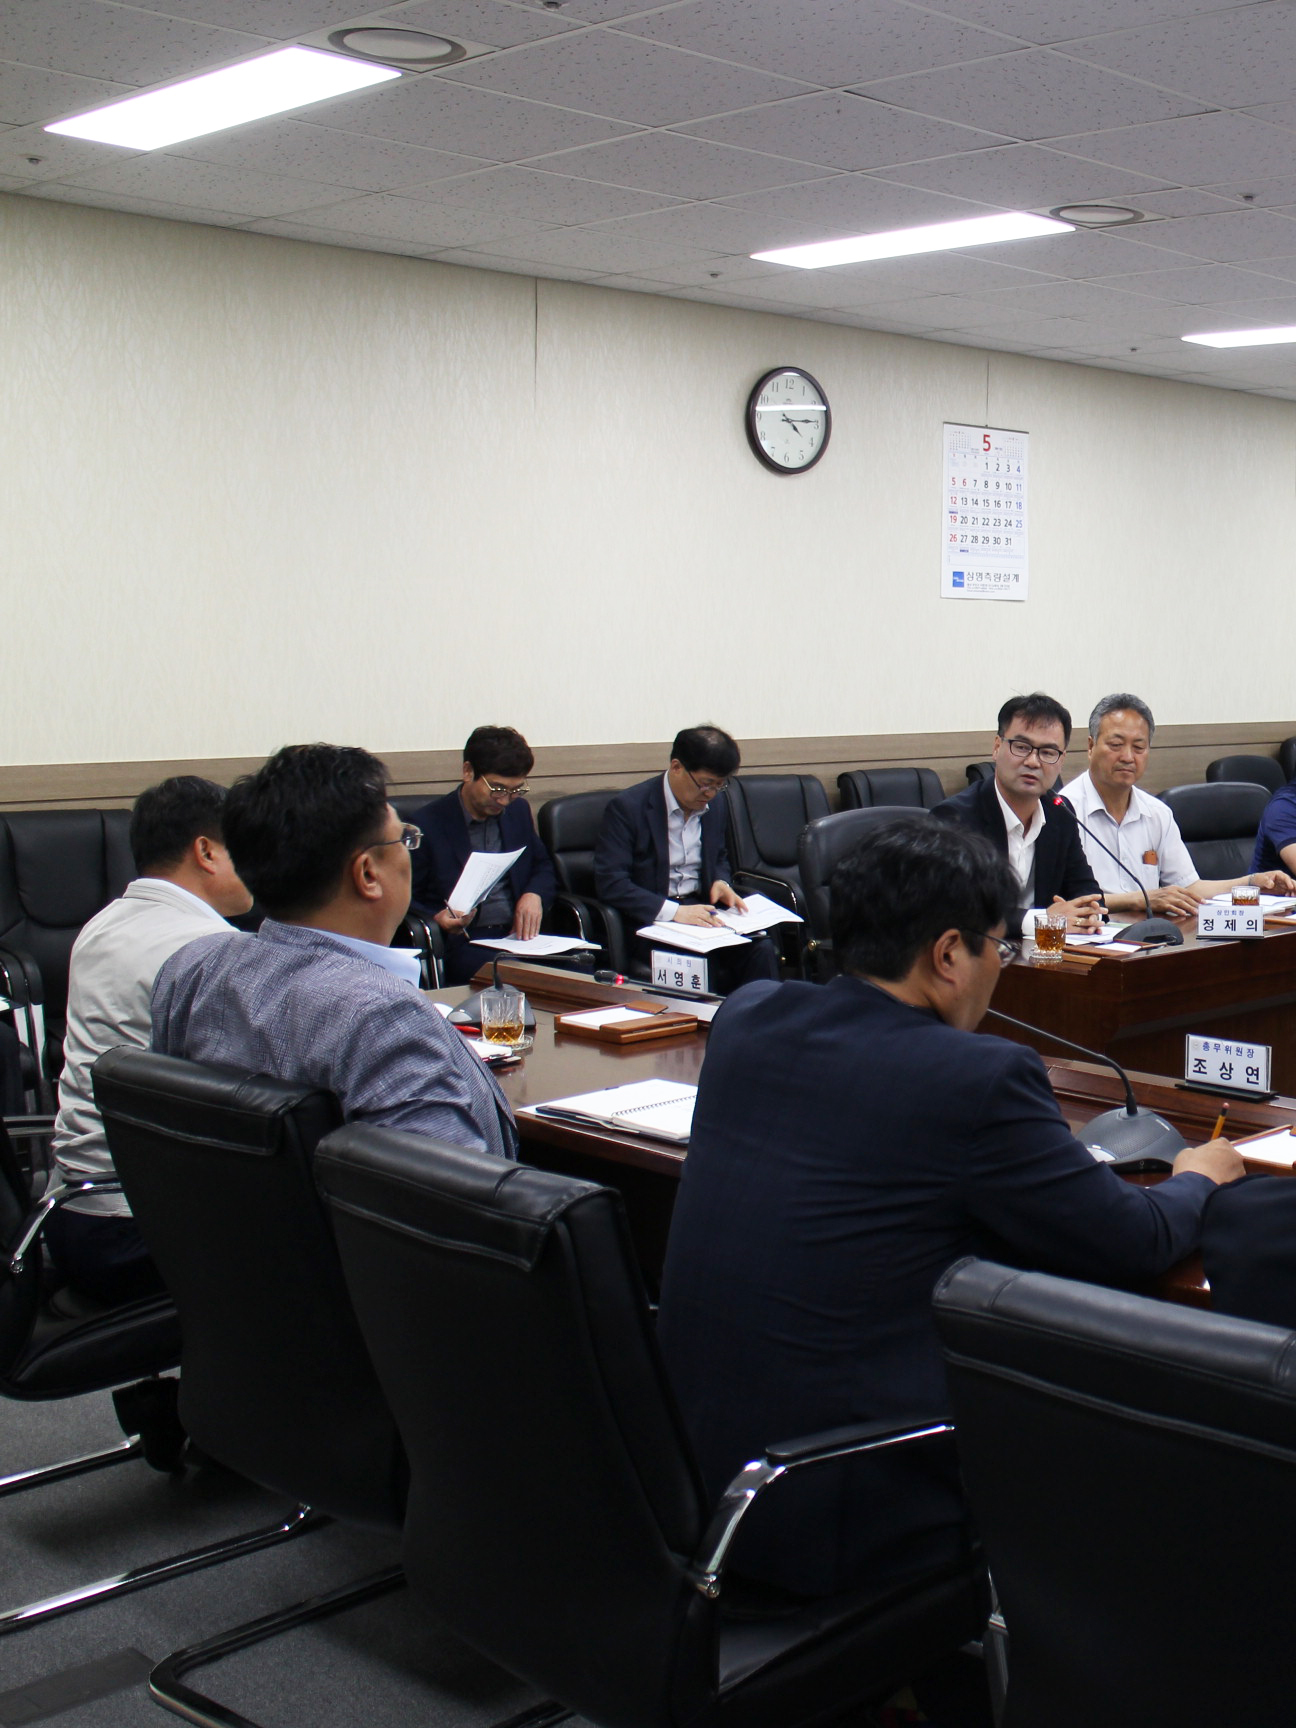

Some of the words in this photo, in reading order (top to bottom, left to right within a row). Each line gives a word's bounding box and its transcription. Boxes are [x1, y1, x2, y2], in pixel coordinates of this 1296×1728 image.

[771, 382, 779, 393] 11
[785, 378, 795, 390] 12
[760, 394, 769, 405] 10
[756, 411, 762, 422] 9
[760, 430, 766, 441] 8
[808, 437, 814, 448] 4
[982, 433, 991, 452] 5
[783, 452, 790, 463] 6
[799, 450, 805, 461] 5
[1005, 482, 1012, 492] 10
[1016, 483, 1022, 492] 11
[950, 496, 957, 505] 12
[961, 497, 968, 506] 13
[971, 498, 979, 507] 14
[982, 499, 990, 508] 15
[994, 500, 1002, 509] 16
[1005, 501, 1012, 510] 17
[1015, 502, 1023, 510] 18
[949, 515, 958, 524] 19
[960, 516, 968, 525] 20
[971, 516, 979, 525] 21
[982, 517, 990, 526] 22
[993, 518, 1002, 527] 23
[1004, 519, 1012, 528] 24
[1015, 519, 1023, 528] 25
[949, 533, 958, 543] 26
[960, 534, 968, 543] 27
[970, 535, 979, 544] 28
[981, 536, 990, 545] 29
[992, 537, 1001, 546] 30
[1004, 537, 1012, 546] 31
[1202, 918, 1258, 932] 정제의
[657, 968, 702, 990] 서영훈
[1202, 1041, 1255, 1059] 총무위원장
[1192, 1057, 1260, 1086] 조상연
